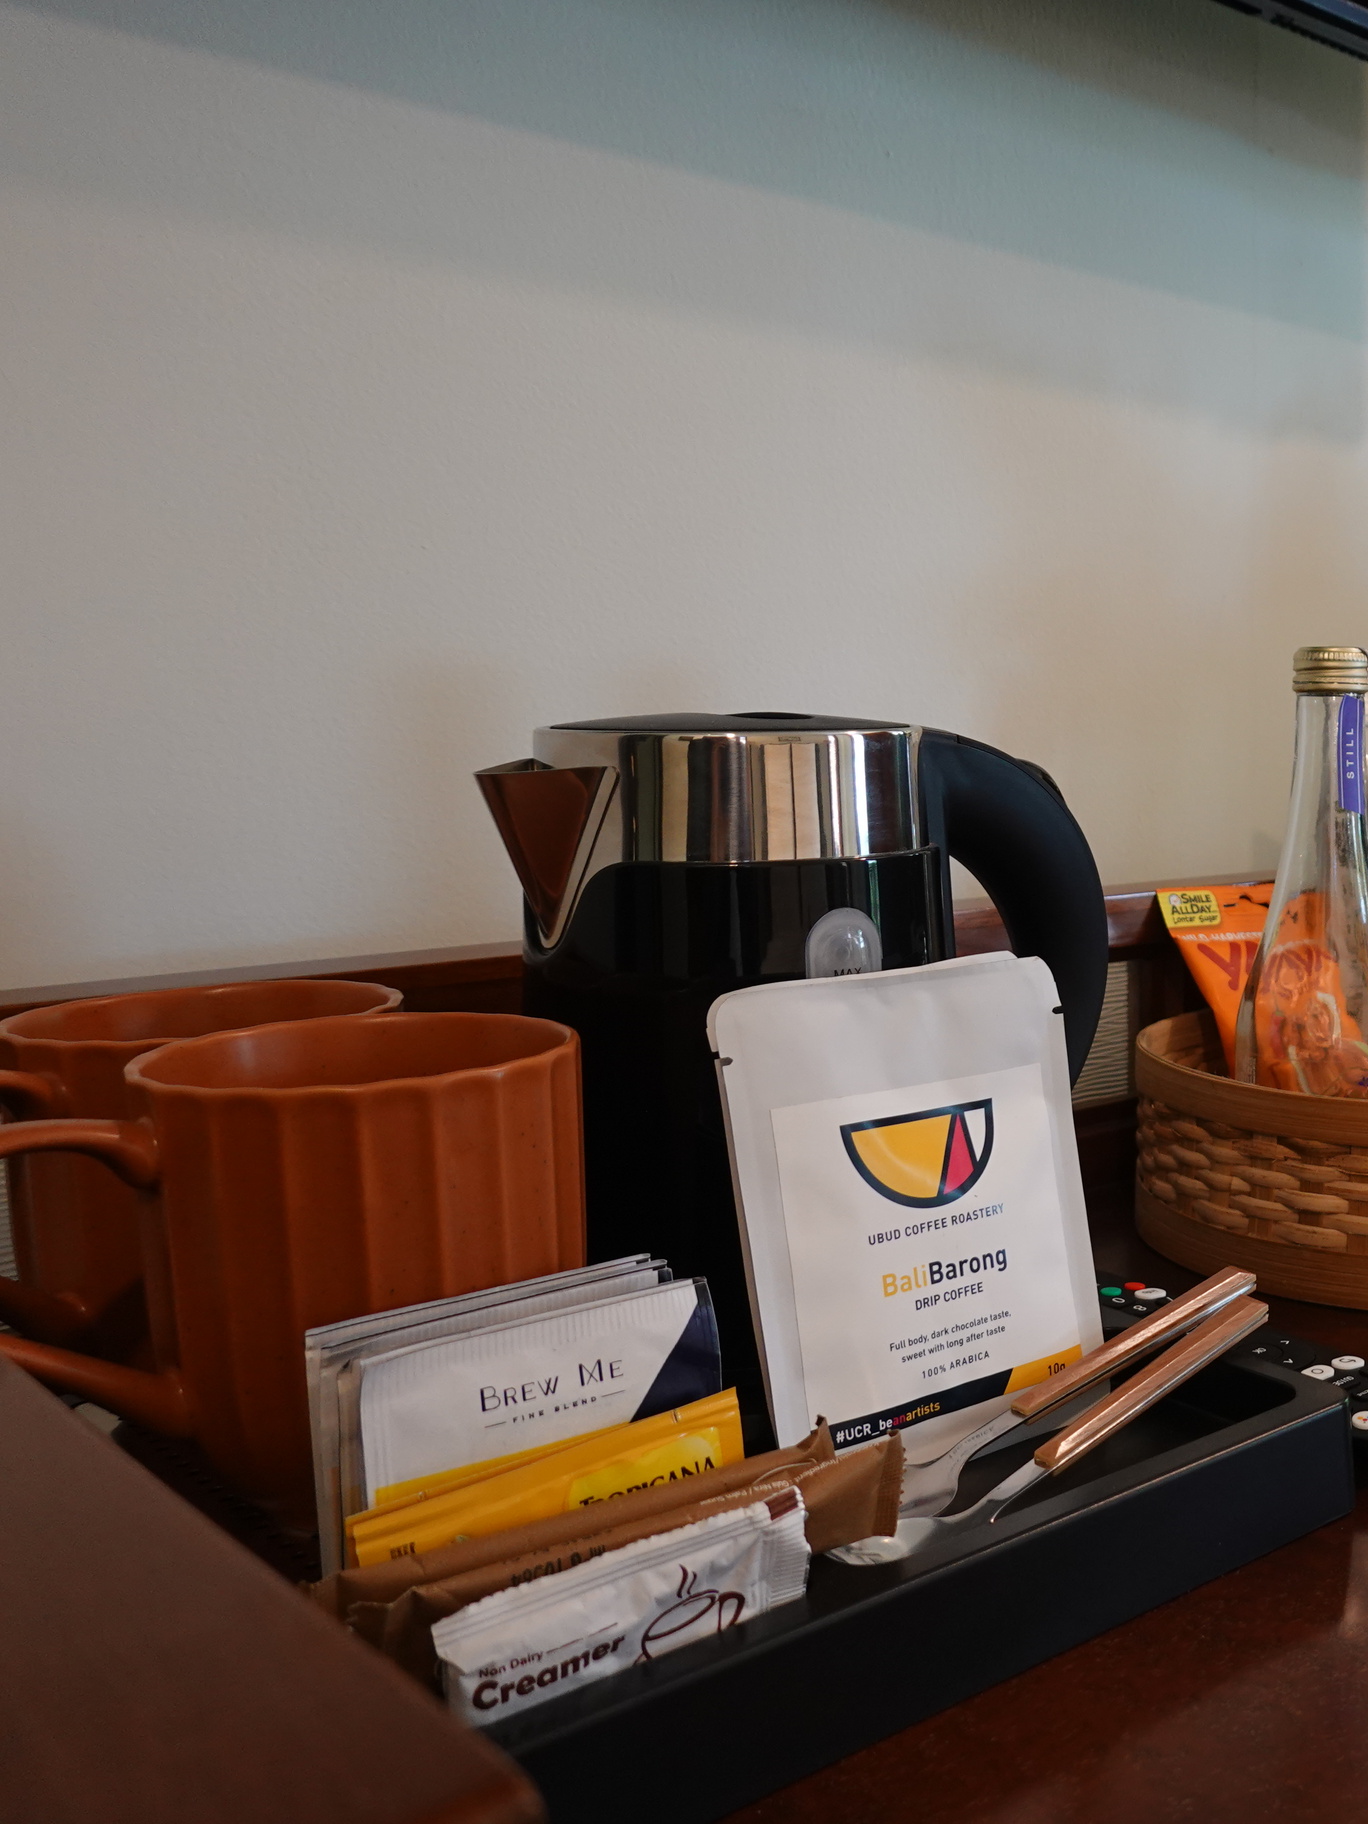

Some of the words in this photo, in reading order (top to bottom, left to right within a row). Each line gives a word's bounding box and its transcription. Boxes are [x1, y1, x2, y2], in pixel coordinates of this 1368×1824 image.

[1346, 728, 1355, 779] STILL
[1181, 893, 1212, 904] SMILE
[1199, 914, 1218, 923] Sugar
[834, 967, 861, 976] MAX
[868, 1229, 901, 1245] UBUD
[904, 1217, 948, 1237] COFFEE
[951, 1203, 1004, 1226] ROASTERY
[882, 1248, 1007, 1298] BaliBarong
[915, 1294, 941, 1310] DRIP
[943, 1282, 984, 1302] COFFEE
[889, 1340, 906, 1351] Full
[908, 1333, 930, 1348] body,
[931, 1328, 950, 1340] dark
[951, 1317, 989, 1333] chocolate
[989, 1309, 1012, 1321] taste,
[901, 1350, 926, 1363] sweet
[928, 1344, 945, 1355] with
[946, 1338, 964, 1348] long
[965, 1332, 985, 1343] after
[986, 1325, 1006, 1337] taste
[922, 1364, 947, 1379] 100%
[949, 1350, 990, 1370] ARABICA
[480, 1375, 559, 1412] BREW
[578, 1359, 624, 1387] ME
[512, 1409, 545, 1423] FINE
[554, 1396, 598, 1412] BLEND
[472, 1634, 626, 1710] Creamer
[479, 1665, 506, 1678] Non
[510, 1651, 544, 1670] Dairy
